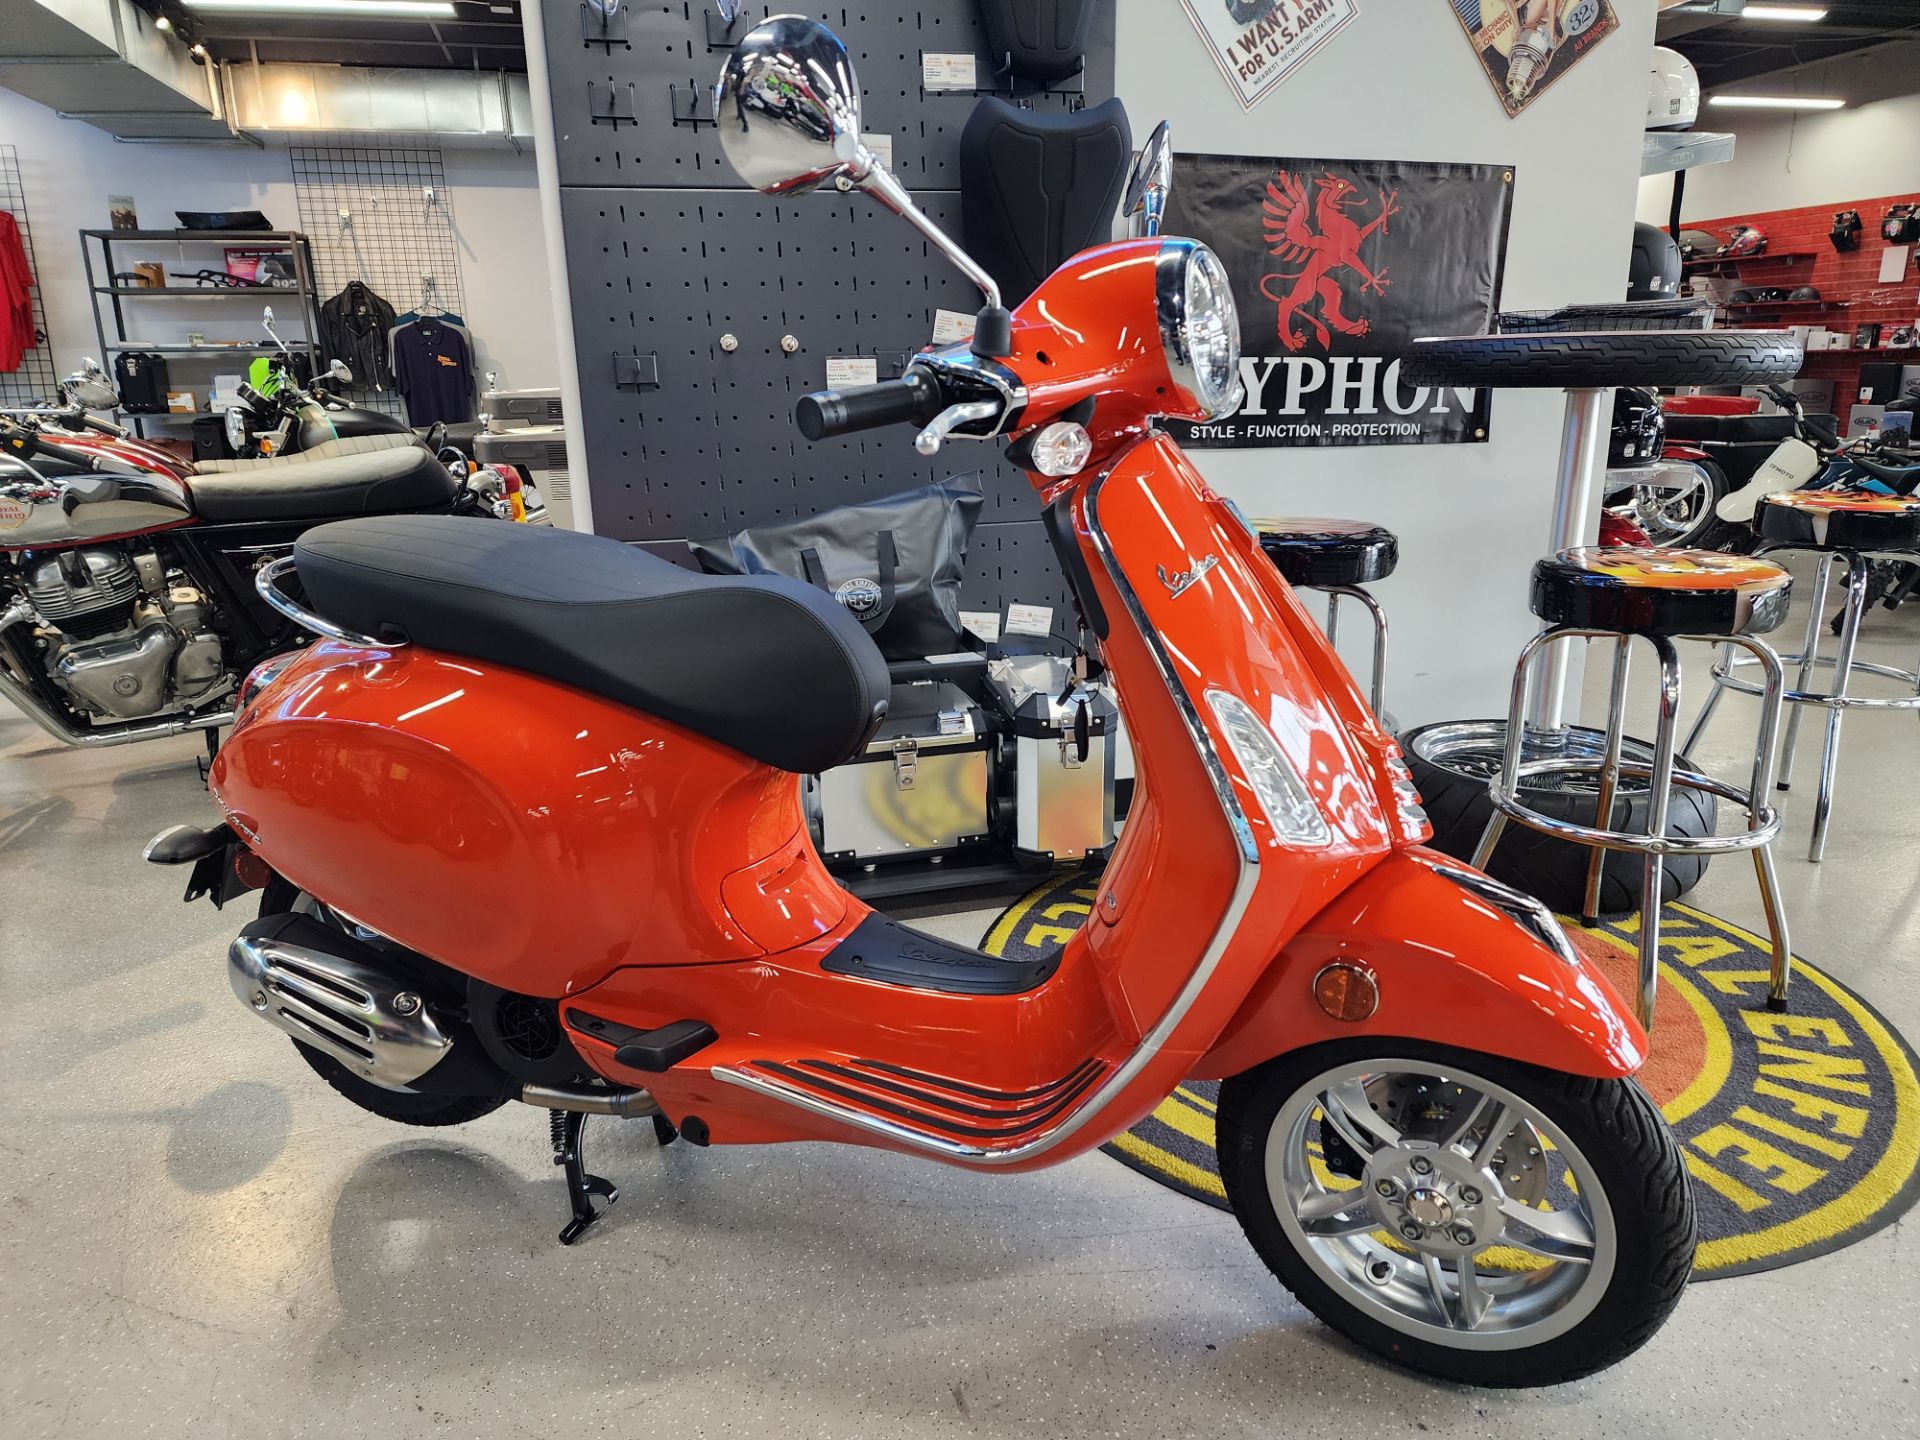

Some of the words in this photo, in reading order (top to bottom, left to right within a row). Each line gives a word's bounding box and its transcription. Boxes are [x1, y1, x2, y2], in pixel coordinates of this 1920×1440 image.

[1226, 47, 1239, 66] I
[1236, 1, 1290, 55] WANT
[1479, 10, 1510, 40] MECHANIC
[1483, 33, 1496, 46] ON
[1495, 18, 1513, 38] DUTY
[1253, 61, 1280, 86] NEAREST
[1280, 32, 1314, 63] RECRUITING
[1313, 13, 1337, 34] STATION
[1238, 53, 1267, 82] FOR
[1190, 425, 1235, 438] STYLE
[1247, 424, 1321, 438] FUNCTION
[1332, 423, 1421, 436] PROTECTION
[1769, 463, 1794, 480] CFMOTO
[1157, 553, 1220, 600] Vespa
